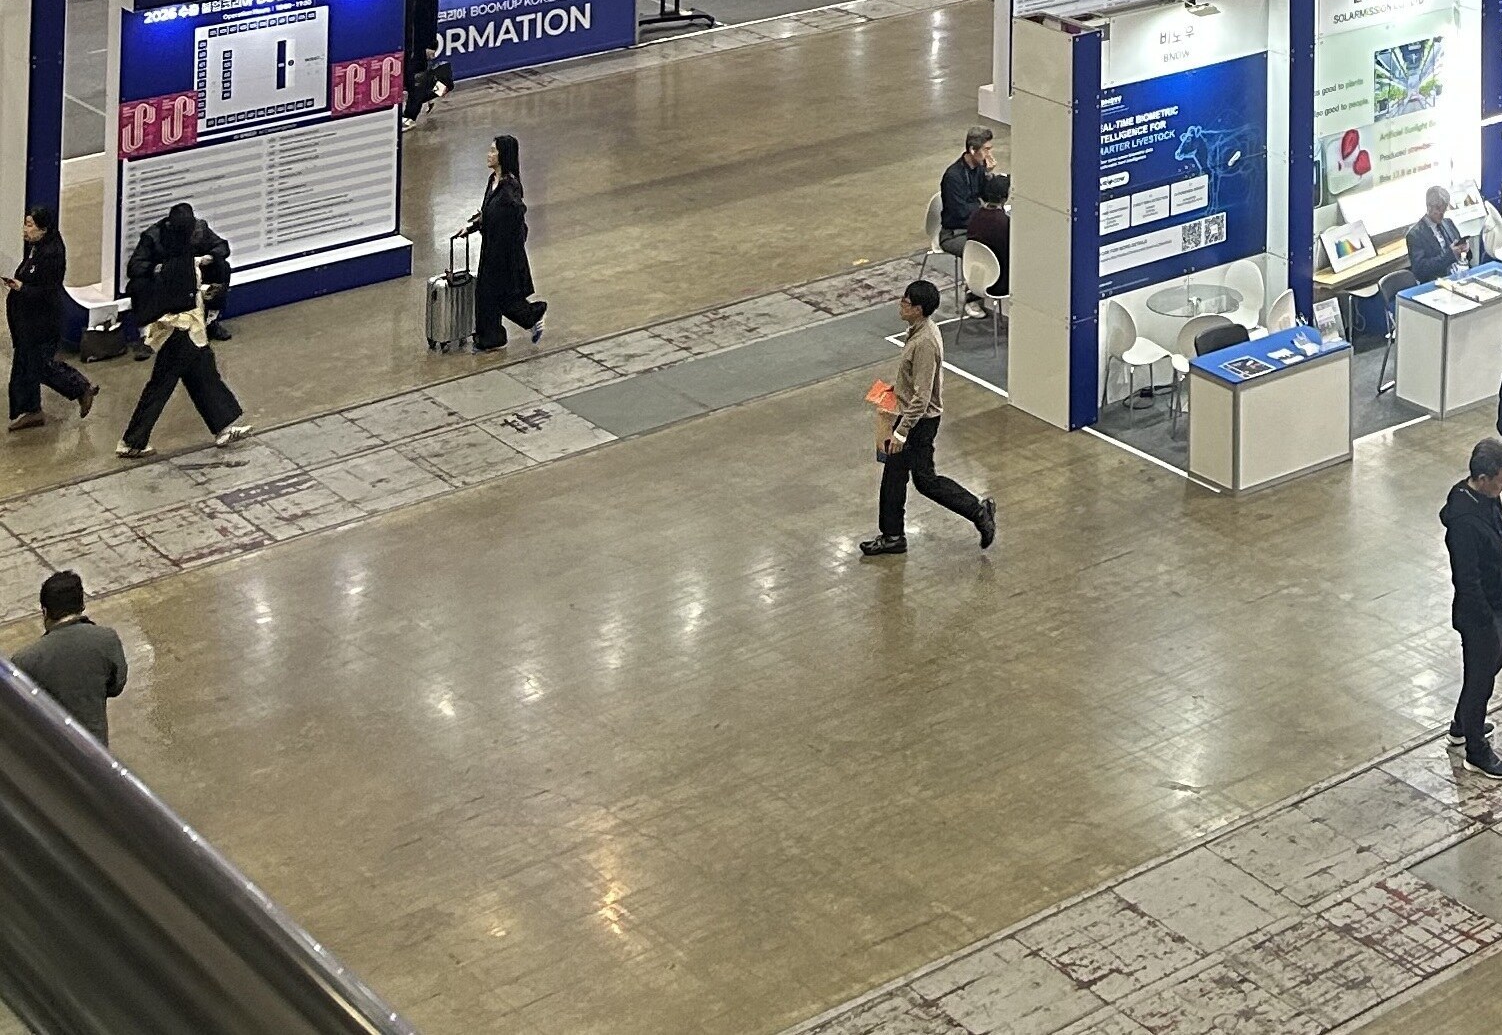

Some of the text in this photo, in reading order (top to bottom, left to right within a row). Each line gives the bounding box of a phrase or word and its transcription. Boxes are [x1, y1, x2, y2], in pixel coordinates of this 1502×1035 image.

[144, 9, 177, 24] 2026
[1136, 106, 1179, 124] BIOMETRIC
[1150, 121, 1166, 132] FOR
[1132, 129, 1176, 148] LIVESTOCK
